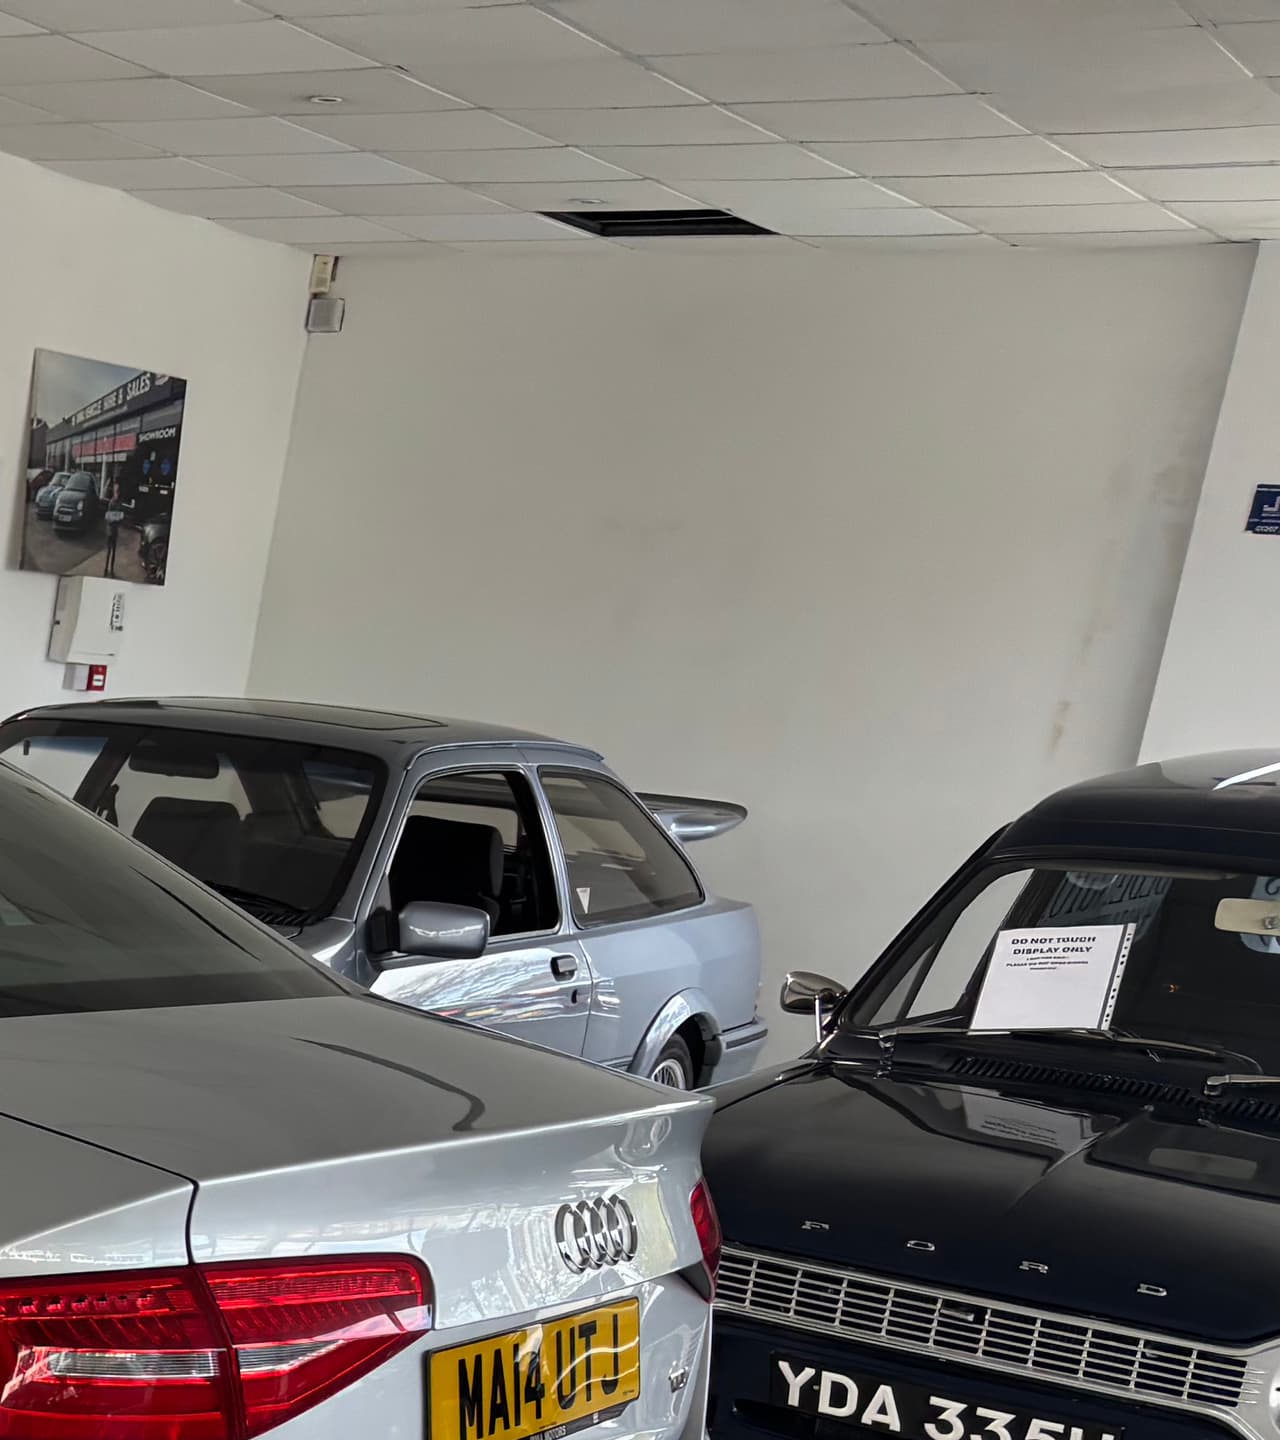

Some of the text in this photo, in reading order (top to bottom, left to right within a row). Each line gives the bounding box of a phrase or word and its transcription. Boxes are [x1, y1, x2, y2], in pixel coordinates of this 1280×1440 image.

[1013, 947, 1061, 955] DISPLAY
[1056, 936, 1096, 944] TOUCH
[555, 1313, 619, 1410] UTJ
[778, 1360, 902, 1432] YDA
